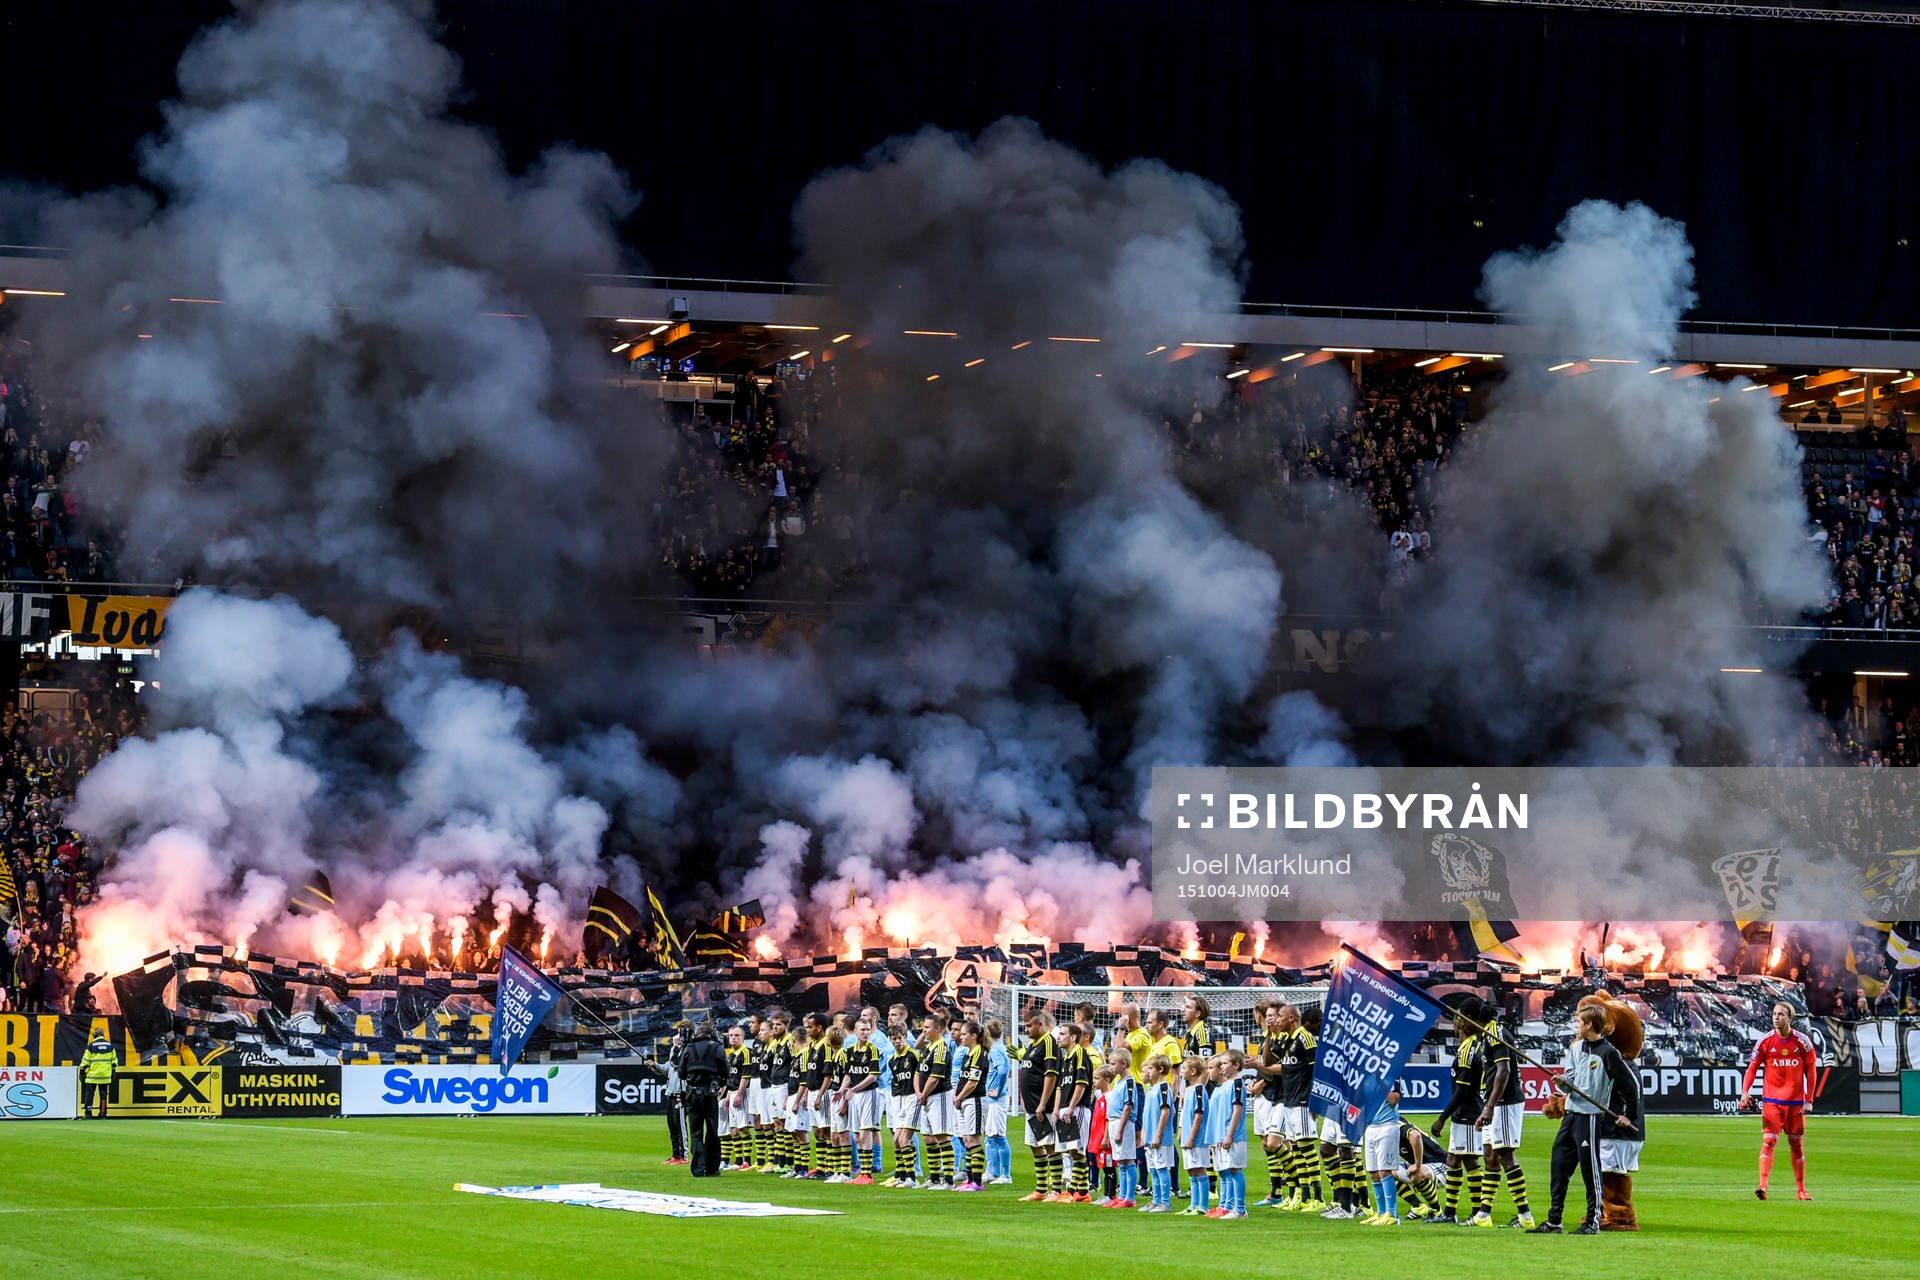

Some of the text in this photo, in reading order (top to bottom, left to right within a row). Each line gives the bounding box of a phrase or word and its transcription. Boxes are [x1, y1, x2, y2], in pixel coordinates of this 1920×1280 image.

[0, 1068, 44, 1081] ÄRN
[239, 1074, 325, 1088] MASKIN-
[381, 1068, 549, 1113] Swegon
[0, 1083, 49, 1117] S
[224, 1092, 340, 1107] UTHYRNING
[167, 1106, 216, 1114] RENTAL
